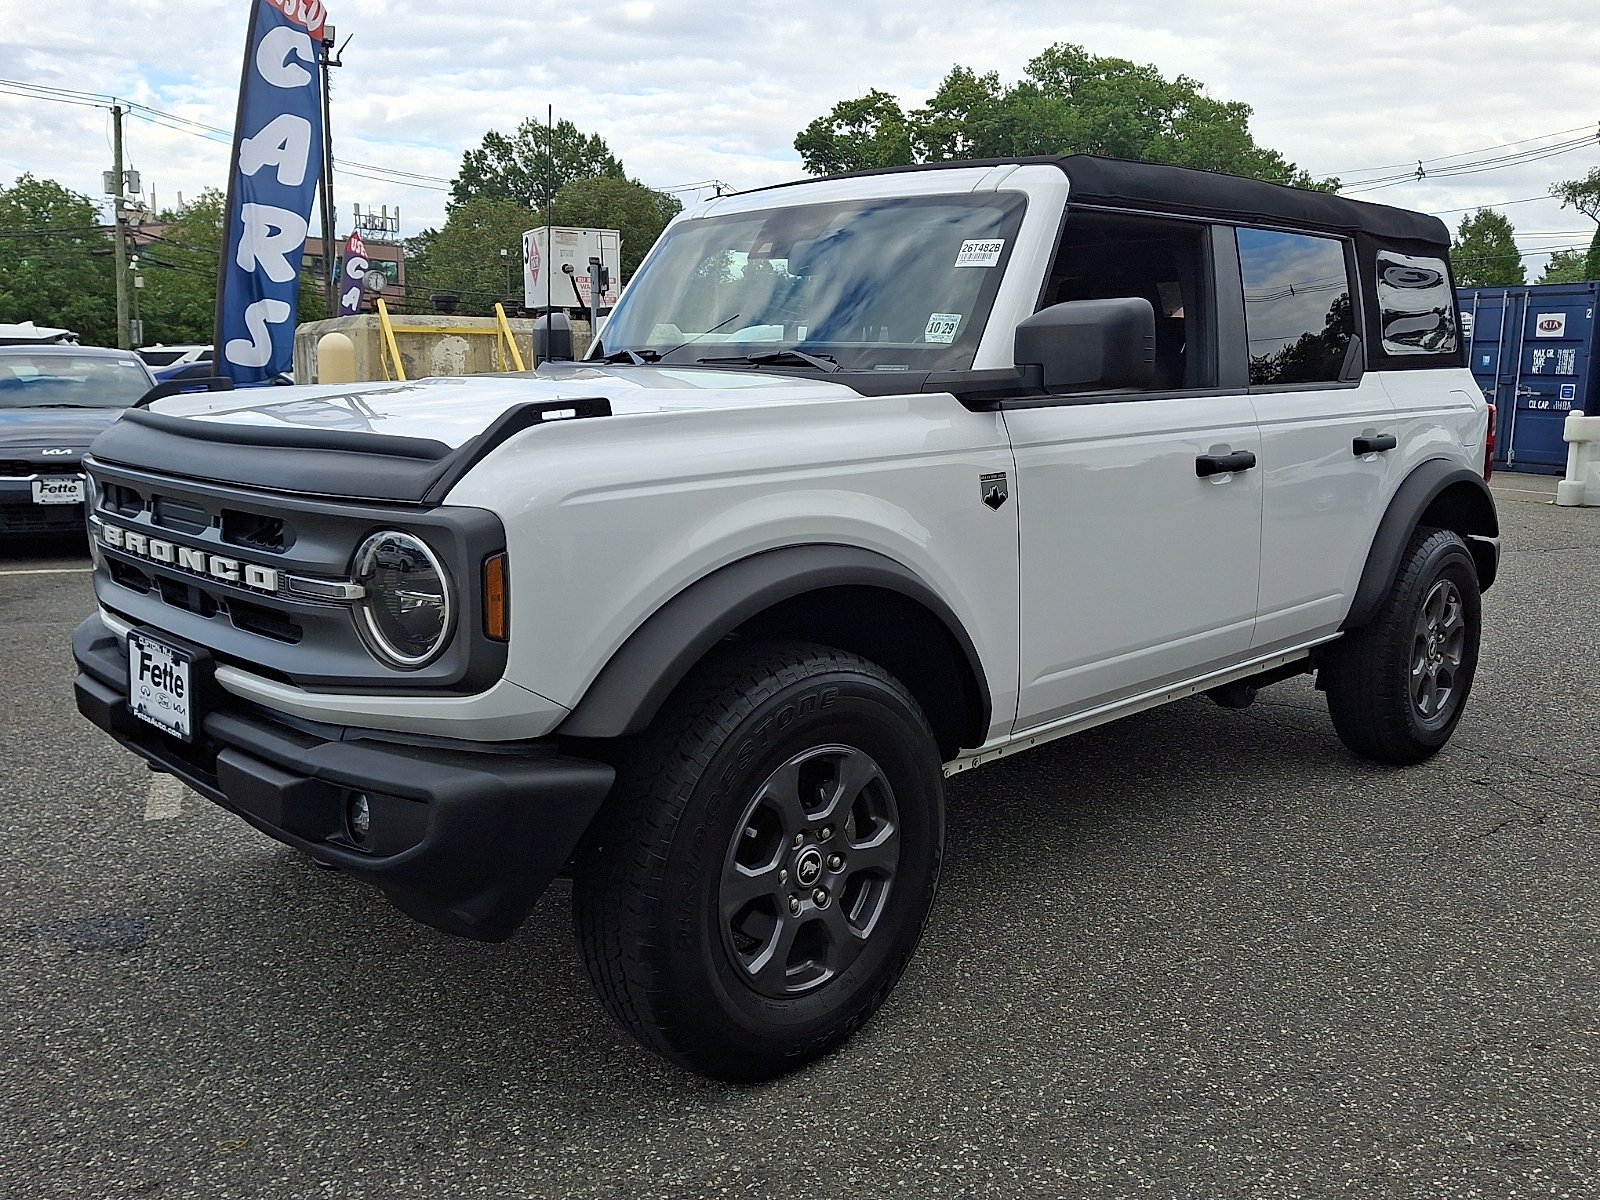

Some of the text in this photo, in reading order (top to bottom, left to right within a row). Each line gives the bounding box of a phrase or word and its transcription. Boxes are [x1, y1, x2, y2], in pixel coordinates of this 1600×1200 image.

[225, 26, 315, 368] CARS
[524, 236, 529, 265] 3
[962, 243, 1001, 253] 26T482B
[927, 322, 955, 335] 10 29
[1542, 320, 1559, 329] KIA
[39, 482, 78, 494] Fette
[103, 523, 279, 592] BRONCO
[138, 651, 185, 699] Fette
